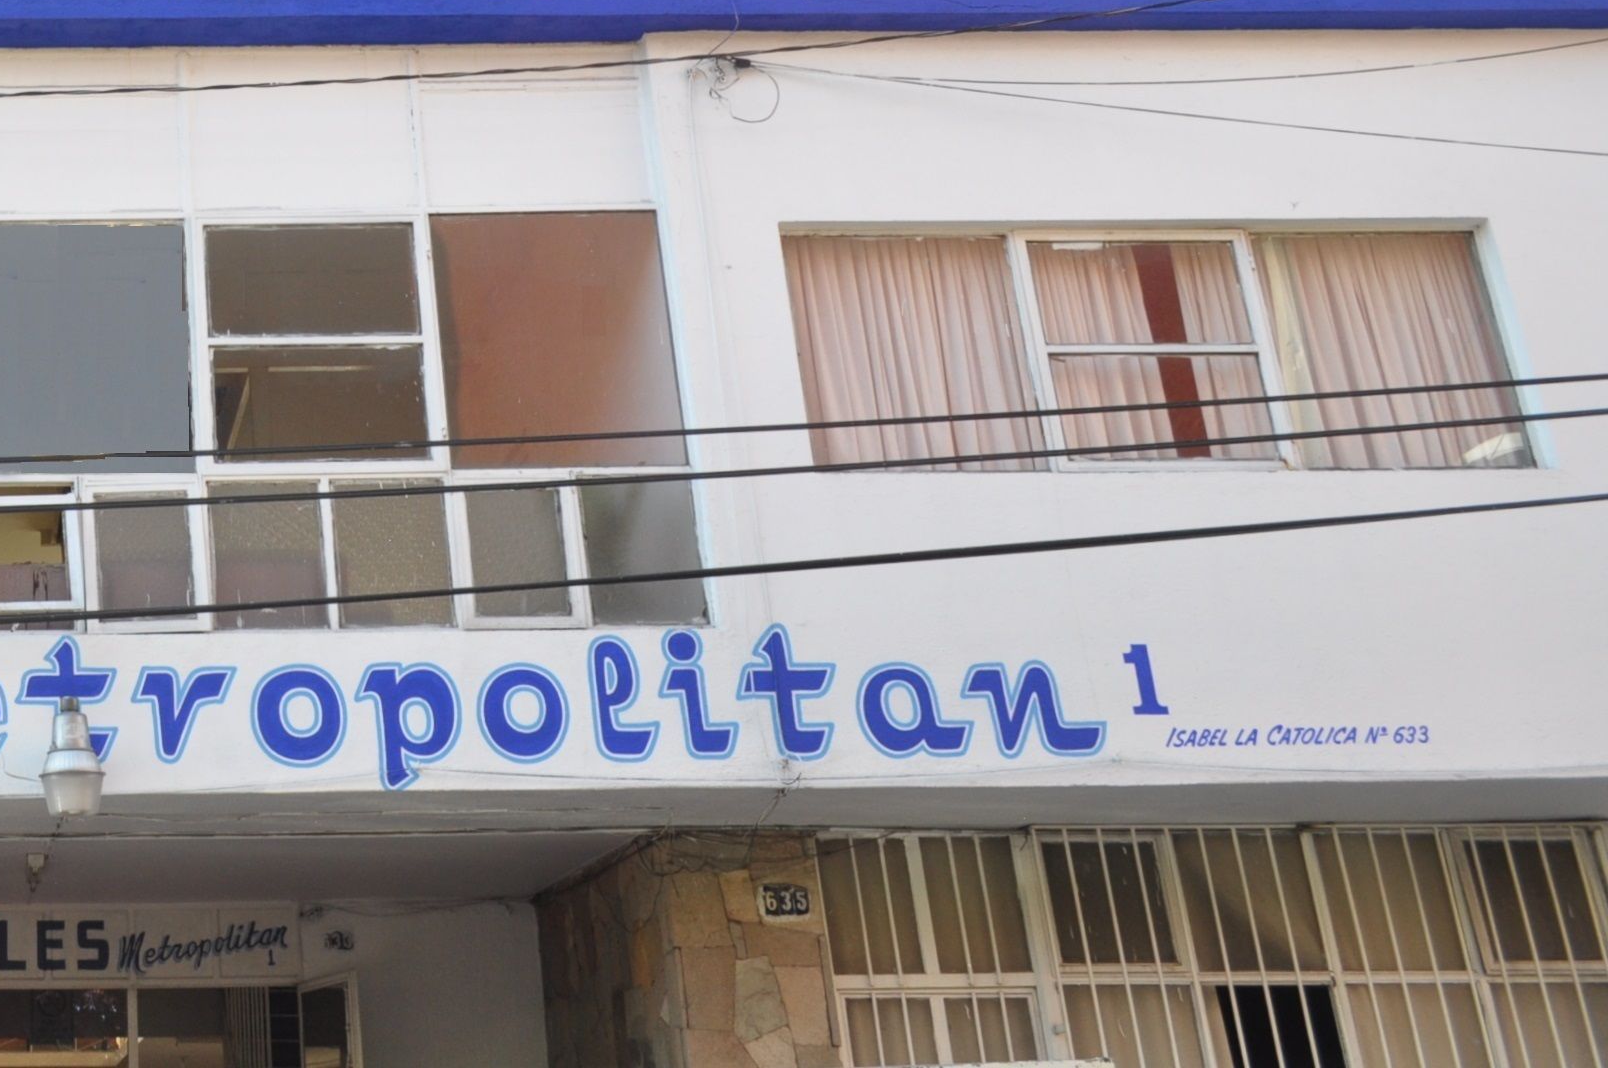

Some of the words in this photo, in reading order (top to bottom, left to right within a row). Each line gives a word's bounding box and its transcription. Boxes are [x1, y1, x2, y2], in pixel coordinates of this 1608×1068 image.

[1123, 644, 1169, 715] 1
[1166, 727, 1227, 748] ISABEL
[1235, 729, 1258, 746] LA
[1266, 724, 1357, 746] CATOLICA
[1393, 725, 1430, 744] 633
[765, 891, 807, 911] 635
[117, 921, 288, 973] Metropolitan
